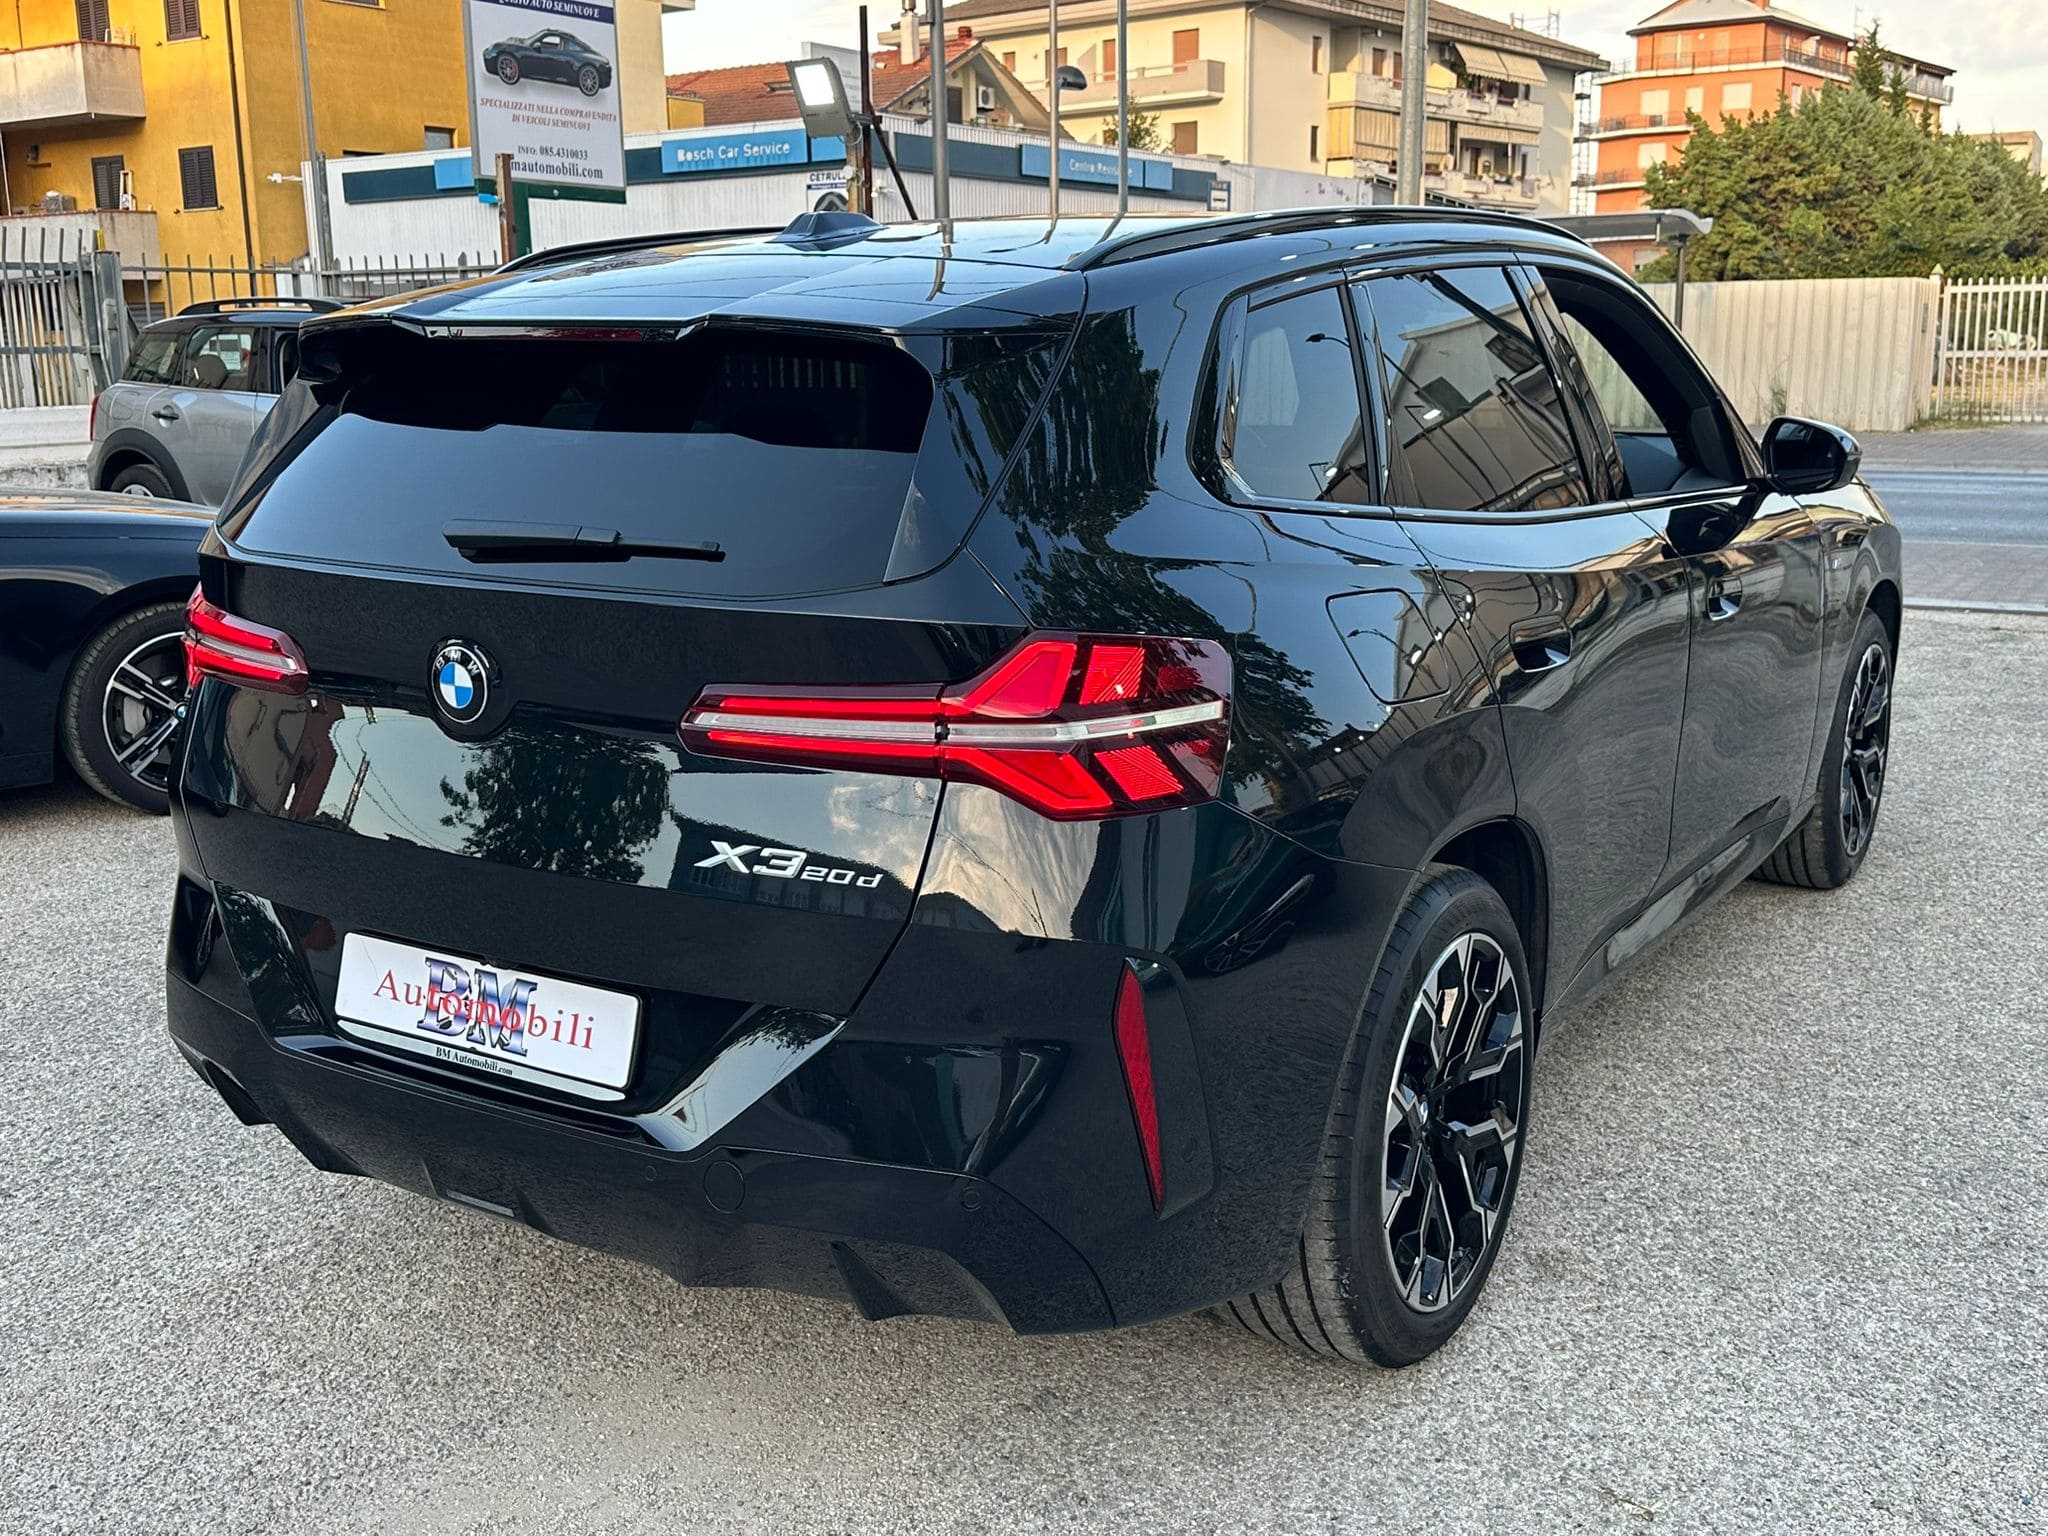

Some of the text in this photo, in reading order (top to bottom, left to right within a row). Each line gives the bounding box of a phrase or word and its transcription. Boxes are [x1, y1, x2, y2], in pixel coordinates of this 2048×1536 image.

[553, 1, 600, 18] SEMINUOVE
[480, 98, 617, 122] SPECIALIZZATI NELLA COMPRAVENDITA
[512, 114, 591, 131] DI VEICOLI SEMINUOVI
[539, 146, 588, 160] 085.4310033
[677, 142, 790, 162] Bosch Car Service
[436, 649, 481, 676] BMW
[373, 969, 595, 1049] Automobili
[417, 957, 538, 1057] BM
[436, 1047, 451, 1059] BM
